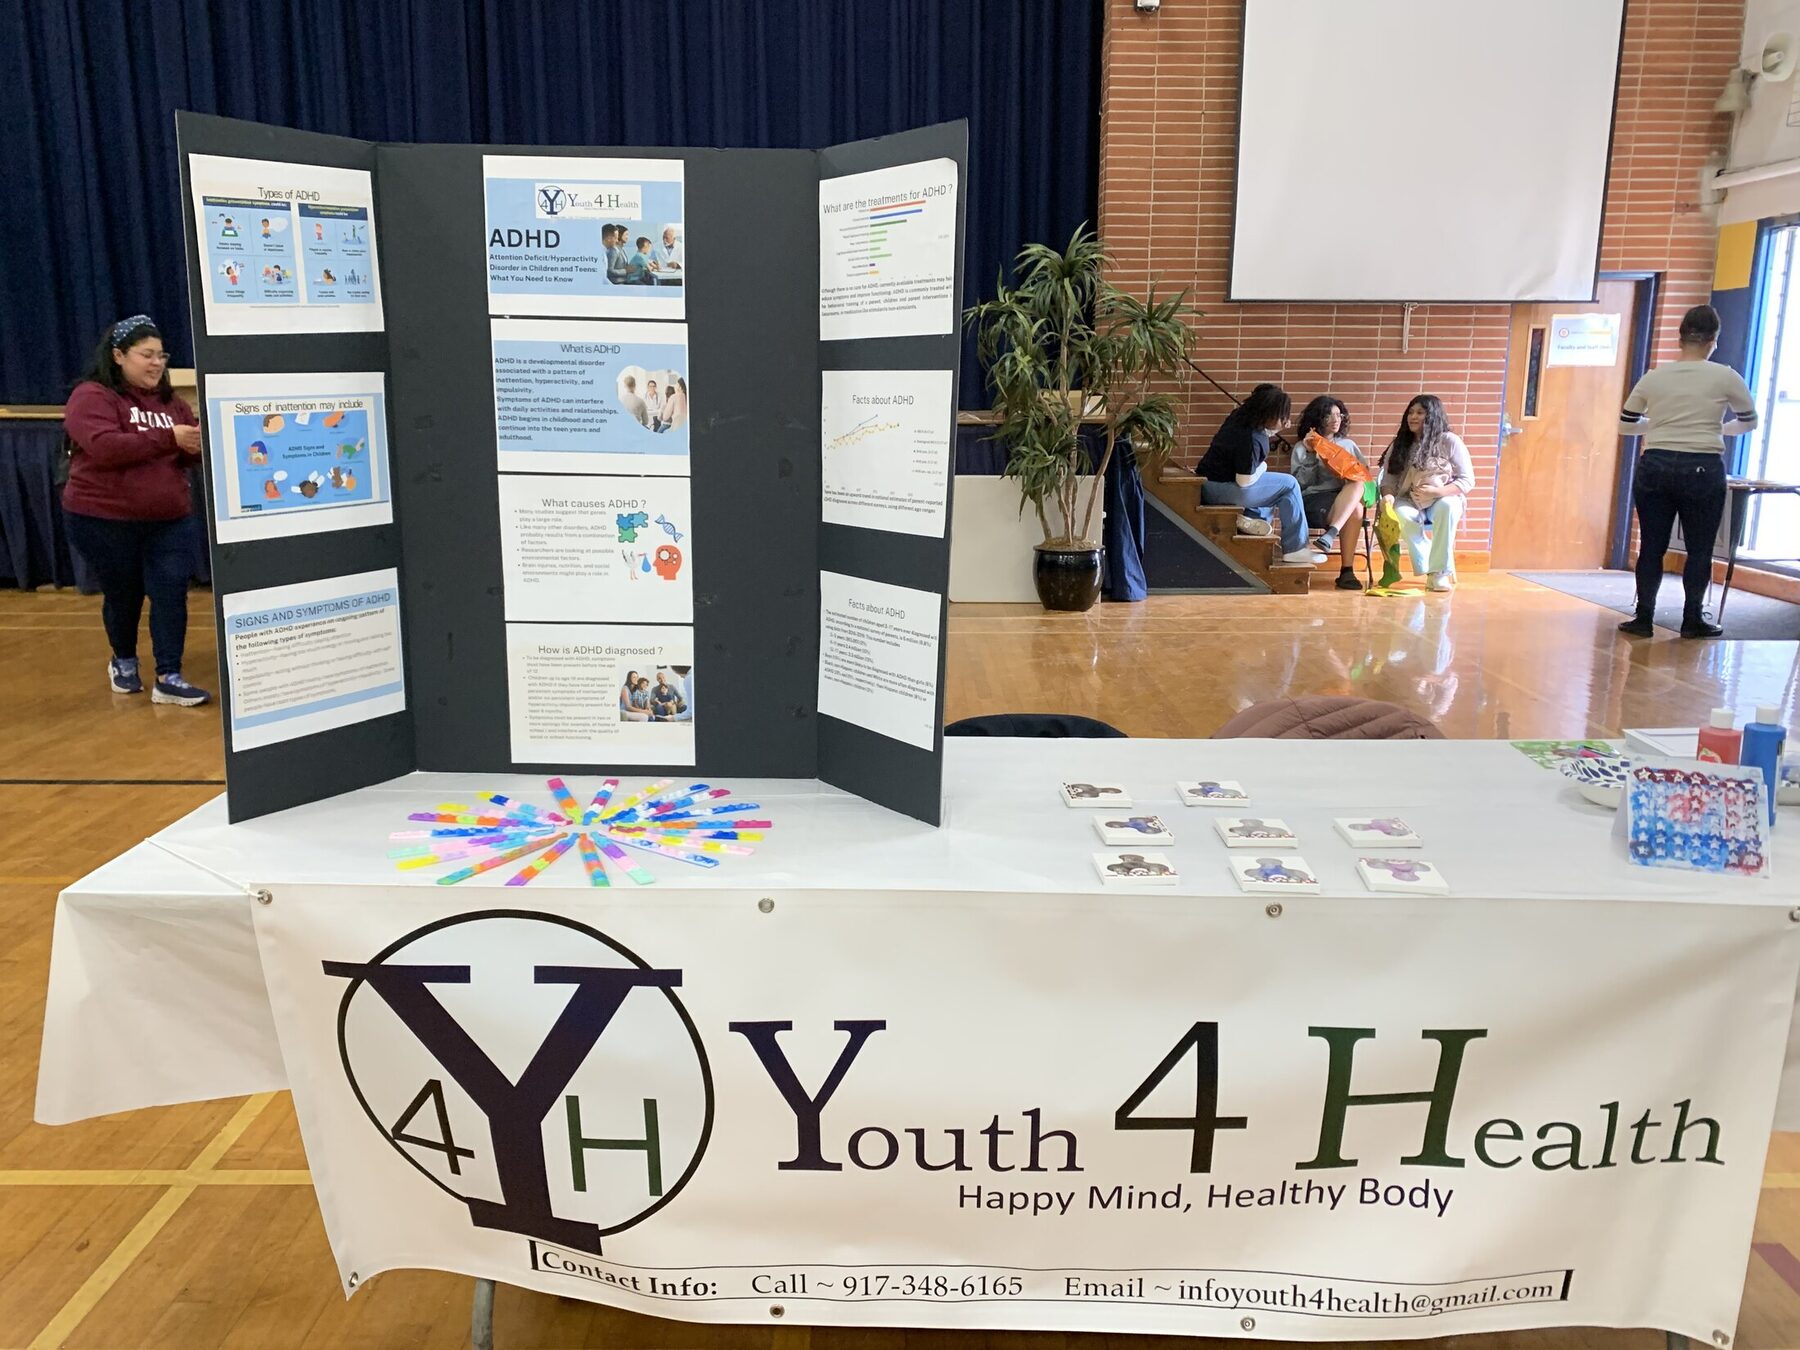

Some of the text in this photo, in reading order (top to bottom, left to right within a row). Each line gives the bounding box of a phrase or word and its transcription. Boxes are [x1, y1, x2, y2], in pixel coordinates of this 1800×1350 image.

[258, 187, 320, 201] Types of ADHD
[568, 194, 639, 209] Youth 4 Health
[823, 203, 841, 213] What
[843, 202, 853, 211] are
[855, 200, 867, 209] the
[868, 193, 907, 206] treatments
[909, 190, 920, 200] for
[922, 185, 946, 198] ADHD
[489, 228, 560, 248] ADHD
[524, 254, 598, 264] Deficit/Hyperactivity
[560, 344, 620, 354] What is ADHD
[235, 400, 363, 414] Signs of inattention may include
[852, 395, 914, 405] Facts about ADHD
[542, 499, 647, 508] What causes ADHD ?
[235, 592, 391, 629] SIGNS AND SYMPTOMS OF ADHD
[848, 598, 905, 619] Facts about ADHD
[235, 632, 258, 640] People
[248, 638, 279, 648] following
[280, 635, 296, 643] types
[538, 645, 560, 654] How
[563, 646, 570, 654] is
[573, 646, 602, 654] ADHD
[605, 646, 655, 656] diagnosed
[728, 1019, 1726, 1174] Youth 4 Health
[321, 960, 683, 1256] Y
[390, 1078, 475, 1176] 4
[566, 1095, 663, 1196] H
[958, 1177, 1454, 1218] Happy Mind, Healthy Body
[542, 1250, 640, 1292] Contact
[648, 1276, 718, 1298] Info:
[752, 1273, 808, 1296] Call
[844, 1275, 1024, 1298] 917-348-6165
[1063, 1276, 1145, 1298] Email
[1178, 1278, 1554, 1317] infoyouth4health@gmail.com
